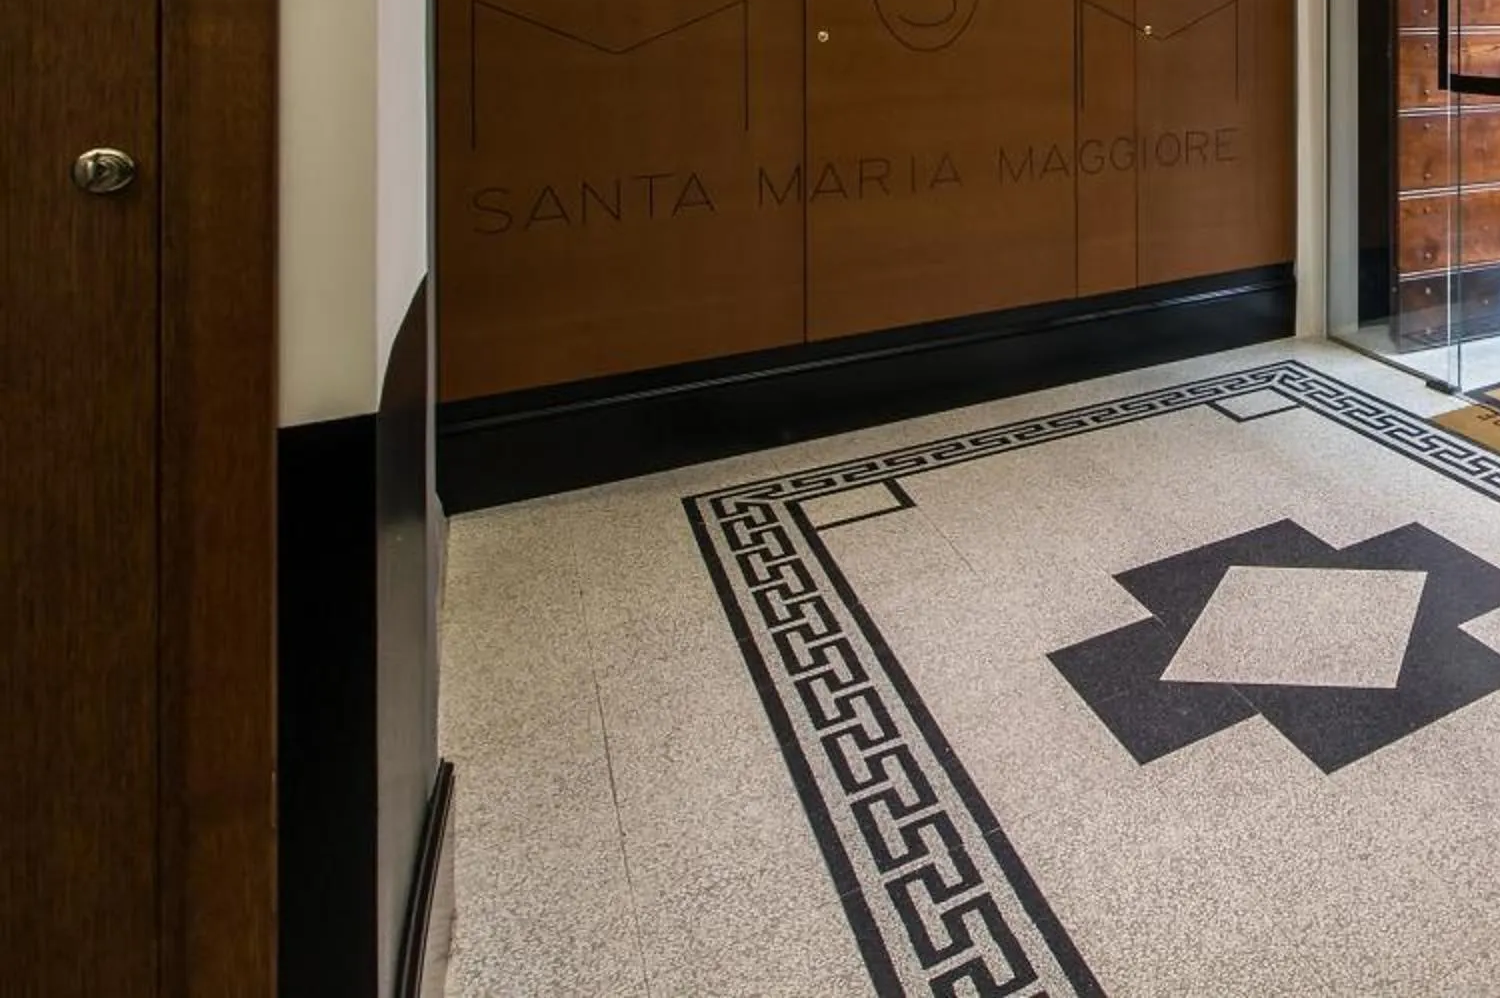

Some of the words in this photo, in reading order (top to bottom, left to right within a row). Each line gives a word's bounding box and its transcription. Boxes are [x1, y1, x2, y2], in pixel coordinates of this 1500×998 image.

[472, 171, 717, 235] SANTA
[758, 152, 963, 208] MARIA
[1000, 128, 1240, 184] MAGGIORE
